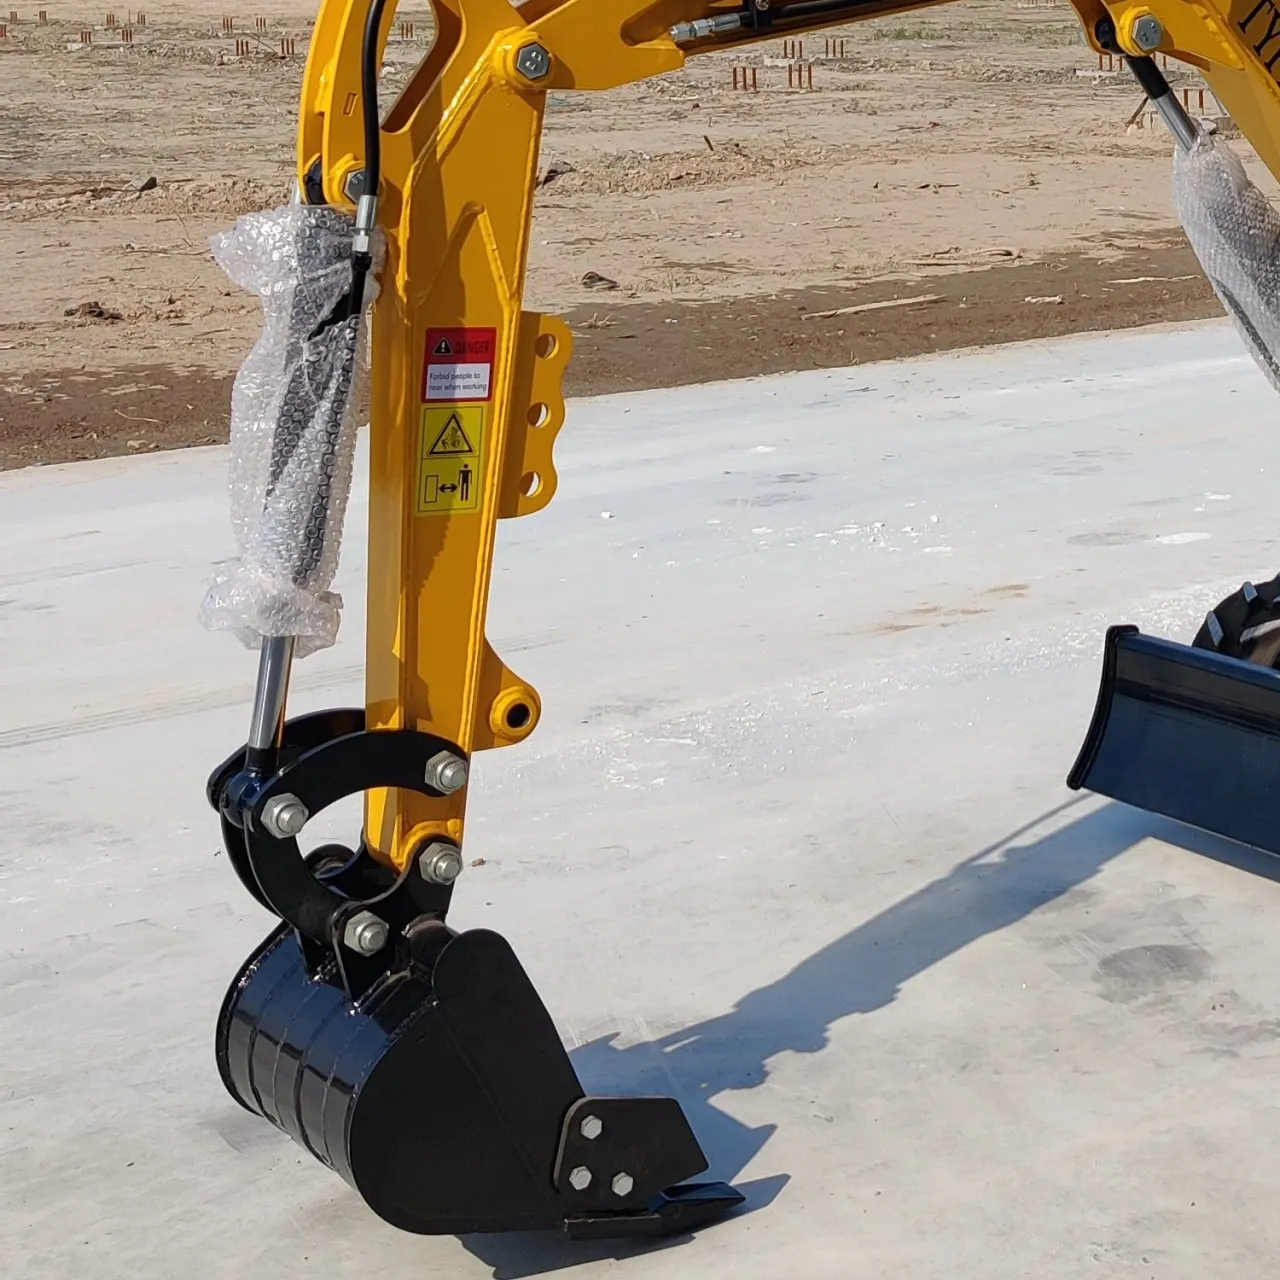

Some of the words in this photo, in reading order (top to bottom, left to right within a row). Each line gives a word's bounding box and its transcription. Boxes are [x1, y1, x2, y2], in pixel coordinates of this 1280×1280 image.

[455, 340, 490, 354] DANGER
[429, 372, 450, 381] Forbid
[451, 372, 473, 382] people
[473, 371, 481, 380] to
[444, 383, 461, 391] when
[463, 381, 487, 392] working
